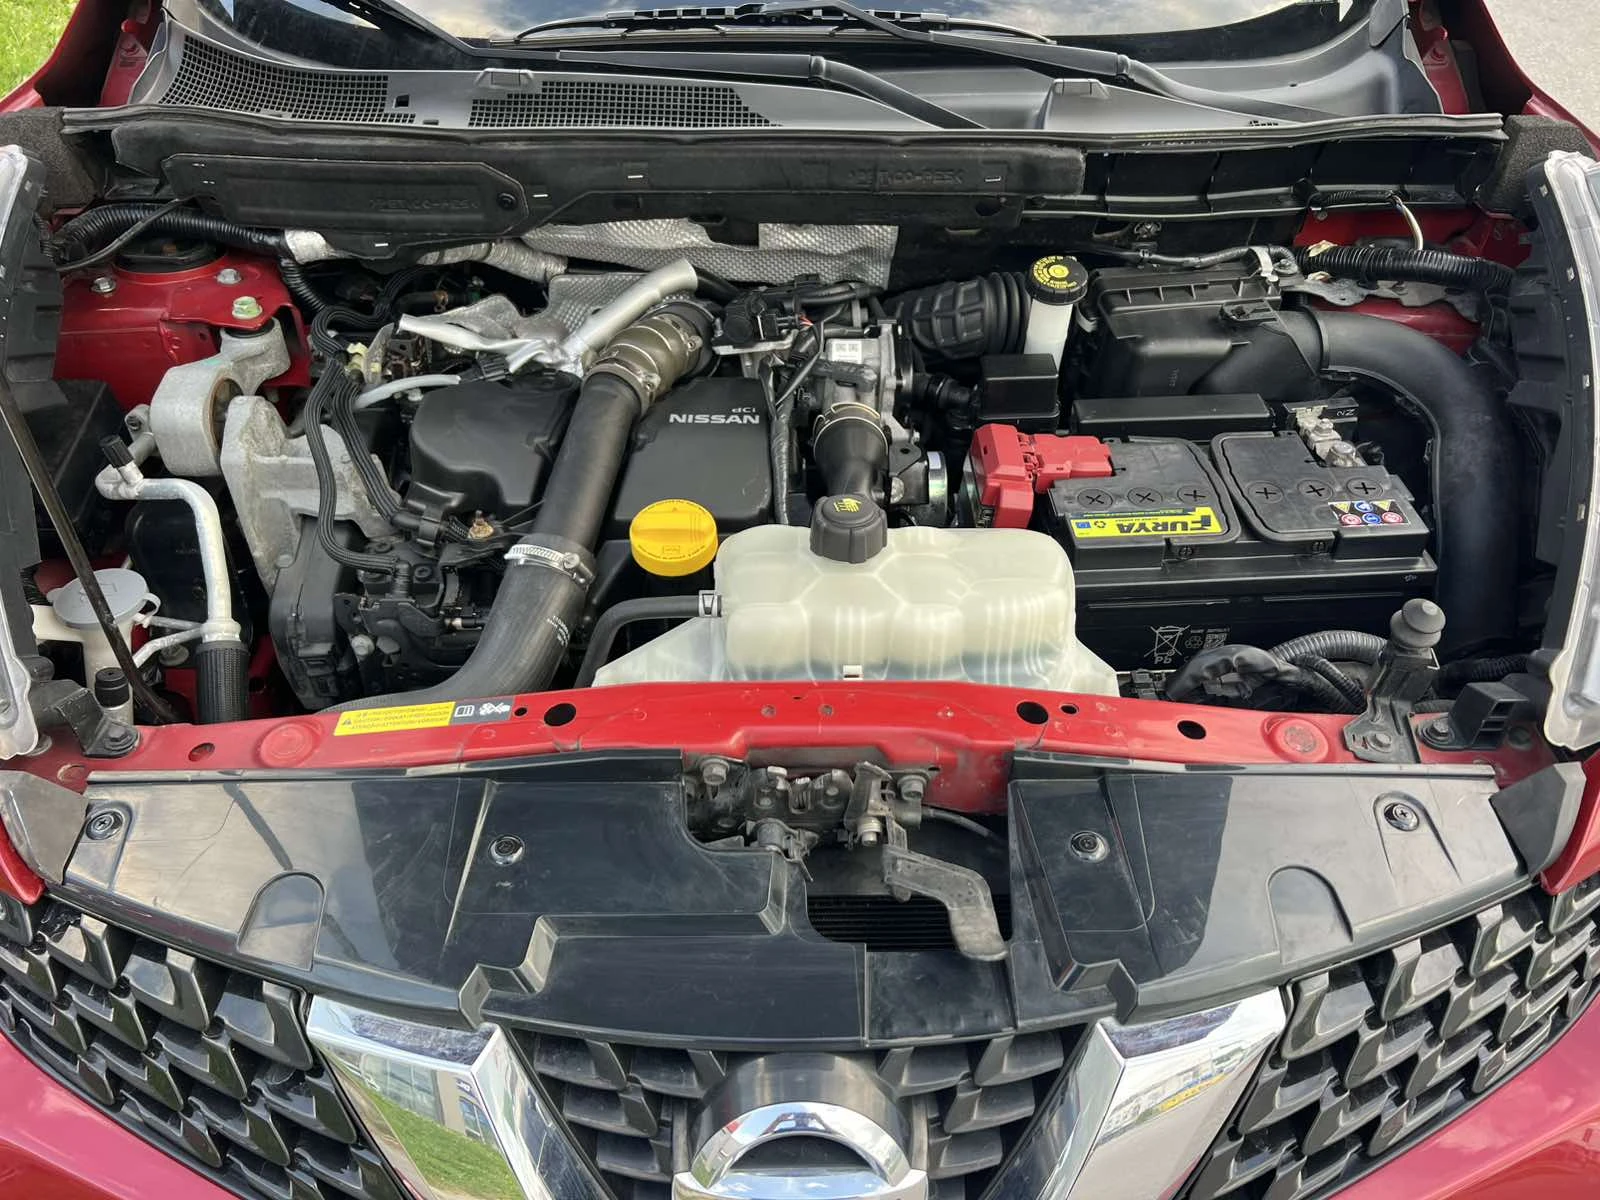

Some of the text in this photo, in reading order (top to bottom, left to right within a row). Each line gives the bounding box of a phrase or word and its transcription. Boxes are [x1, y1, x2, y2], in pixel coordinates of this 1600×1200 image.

[669, 413, 760, 424] NISSAN
[1116, 514, 1212, 534] FURYA
[1154, 656, 1172, 664] Pb
